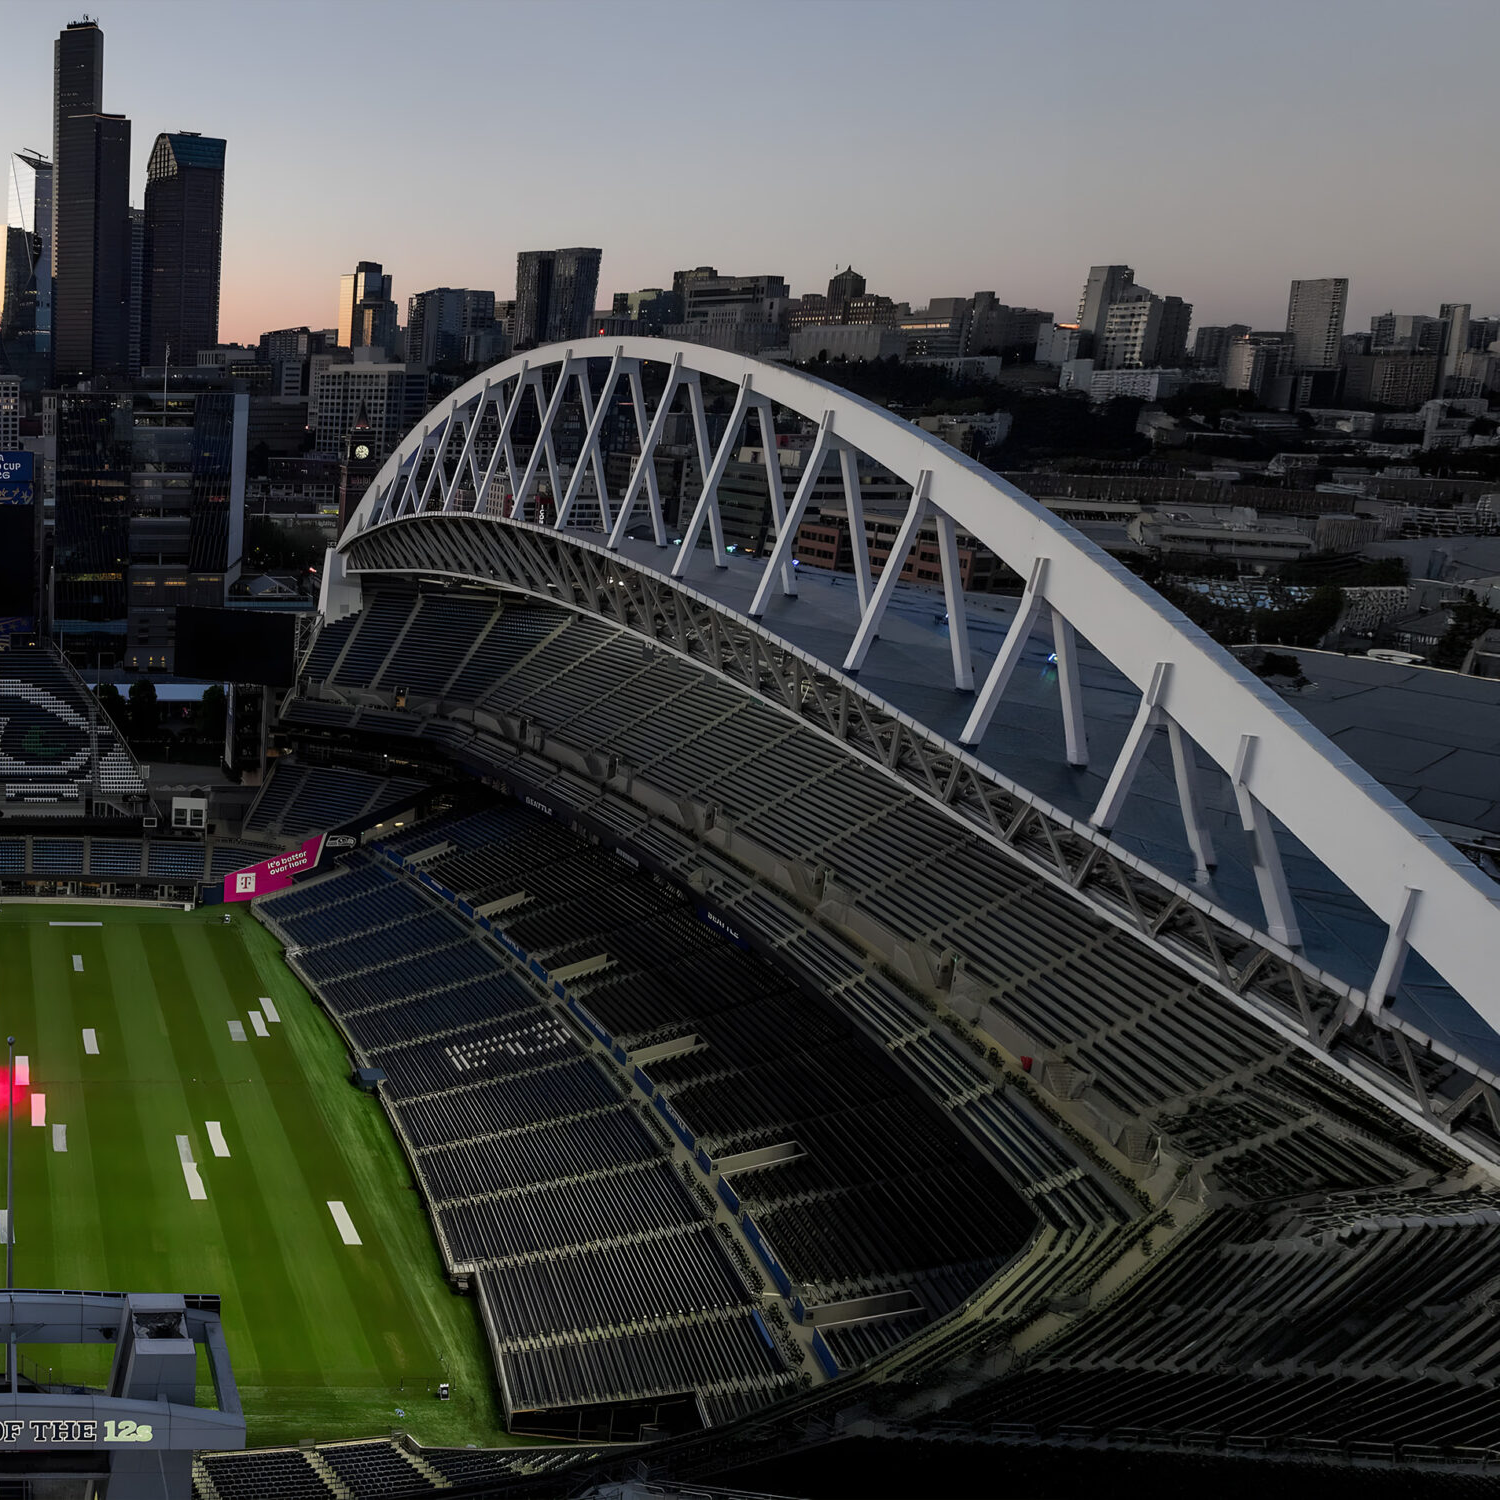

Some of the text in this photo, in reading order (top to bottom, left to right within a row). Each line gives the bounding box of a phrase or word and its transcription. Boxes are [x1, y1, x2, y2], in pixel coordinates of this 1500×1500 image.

[3, 462, 21, 471] CUP
[29, 1420, 97, 1442] THE
[103, 1420, 153, 1443] 12s
